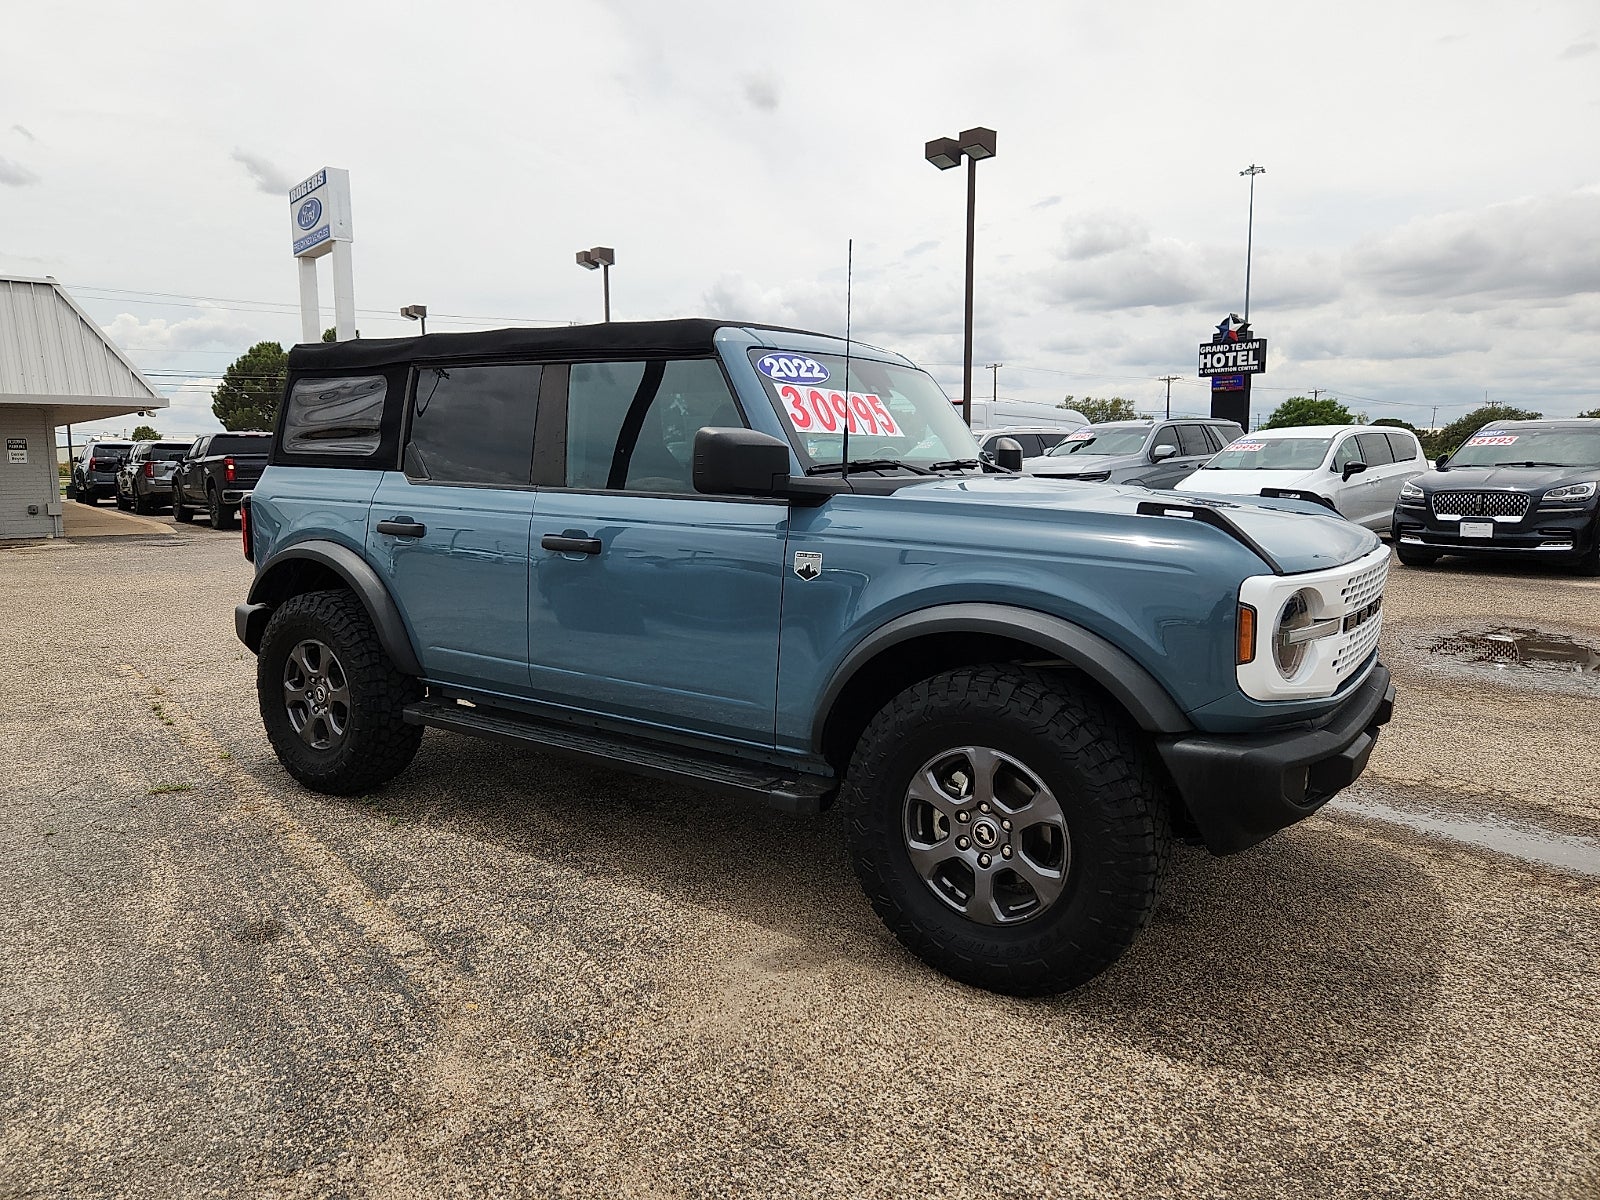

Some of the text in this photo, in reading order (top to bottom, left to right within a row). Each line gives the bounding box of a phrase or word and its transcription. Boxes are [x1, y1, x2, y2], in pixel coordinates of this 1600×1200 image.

[291, 172, 324, 202] ROGERS
[1200, 341, 1259, 354] GRAND TEXAN
[763, 357, 827, 378] 2022
[1199, 351, 1259, 369] HOTEL
[1238, 364, 1258, 372] CENTER
[781, 386, 897, 434] 30995
